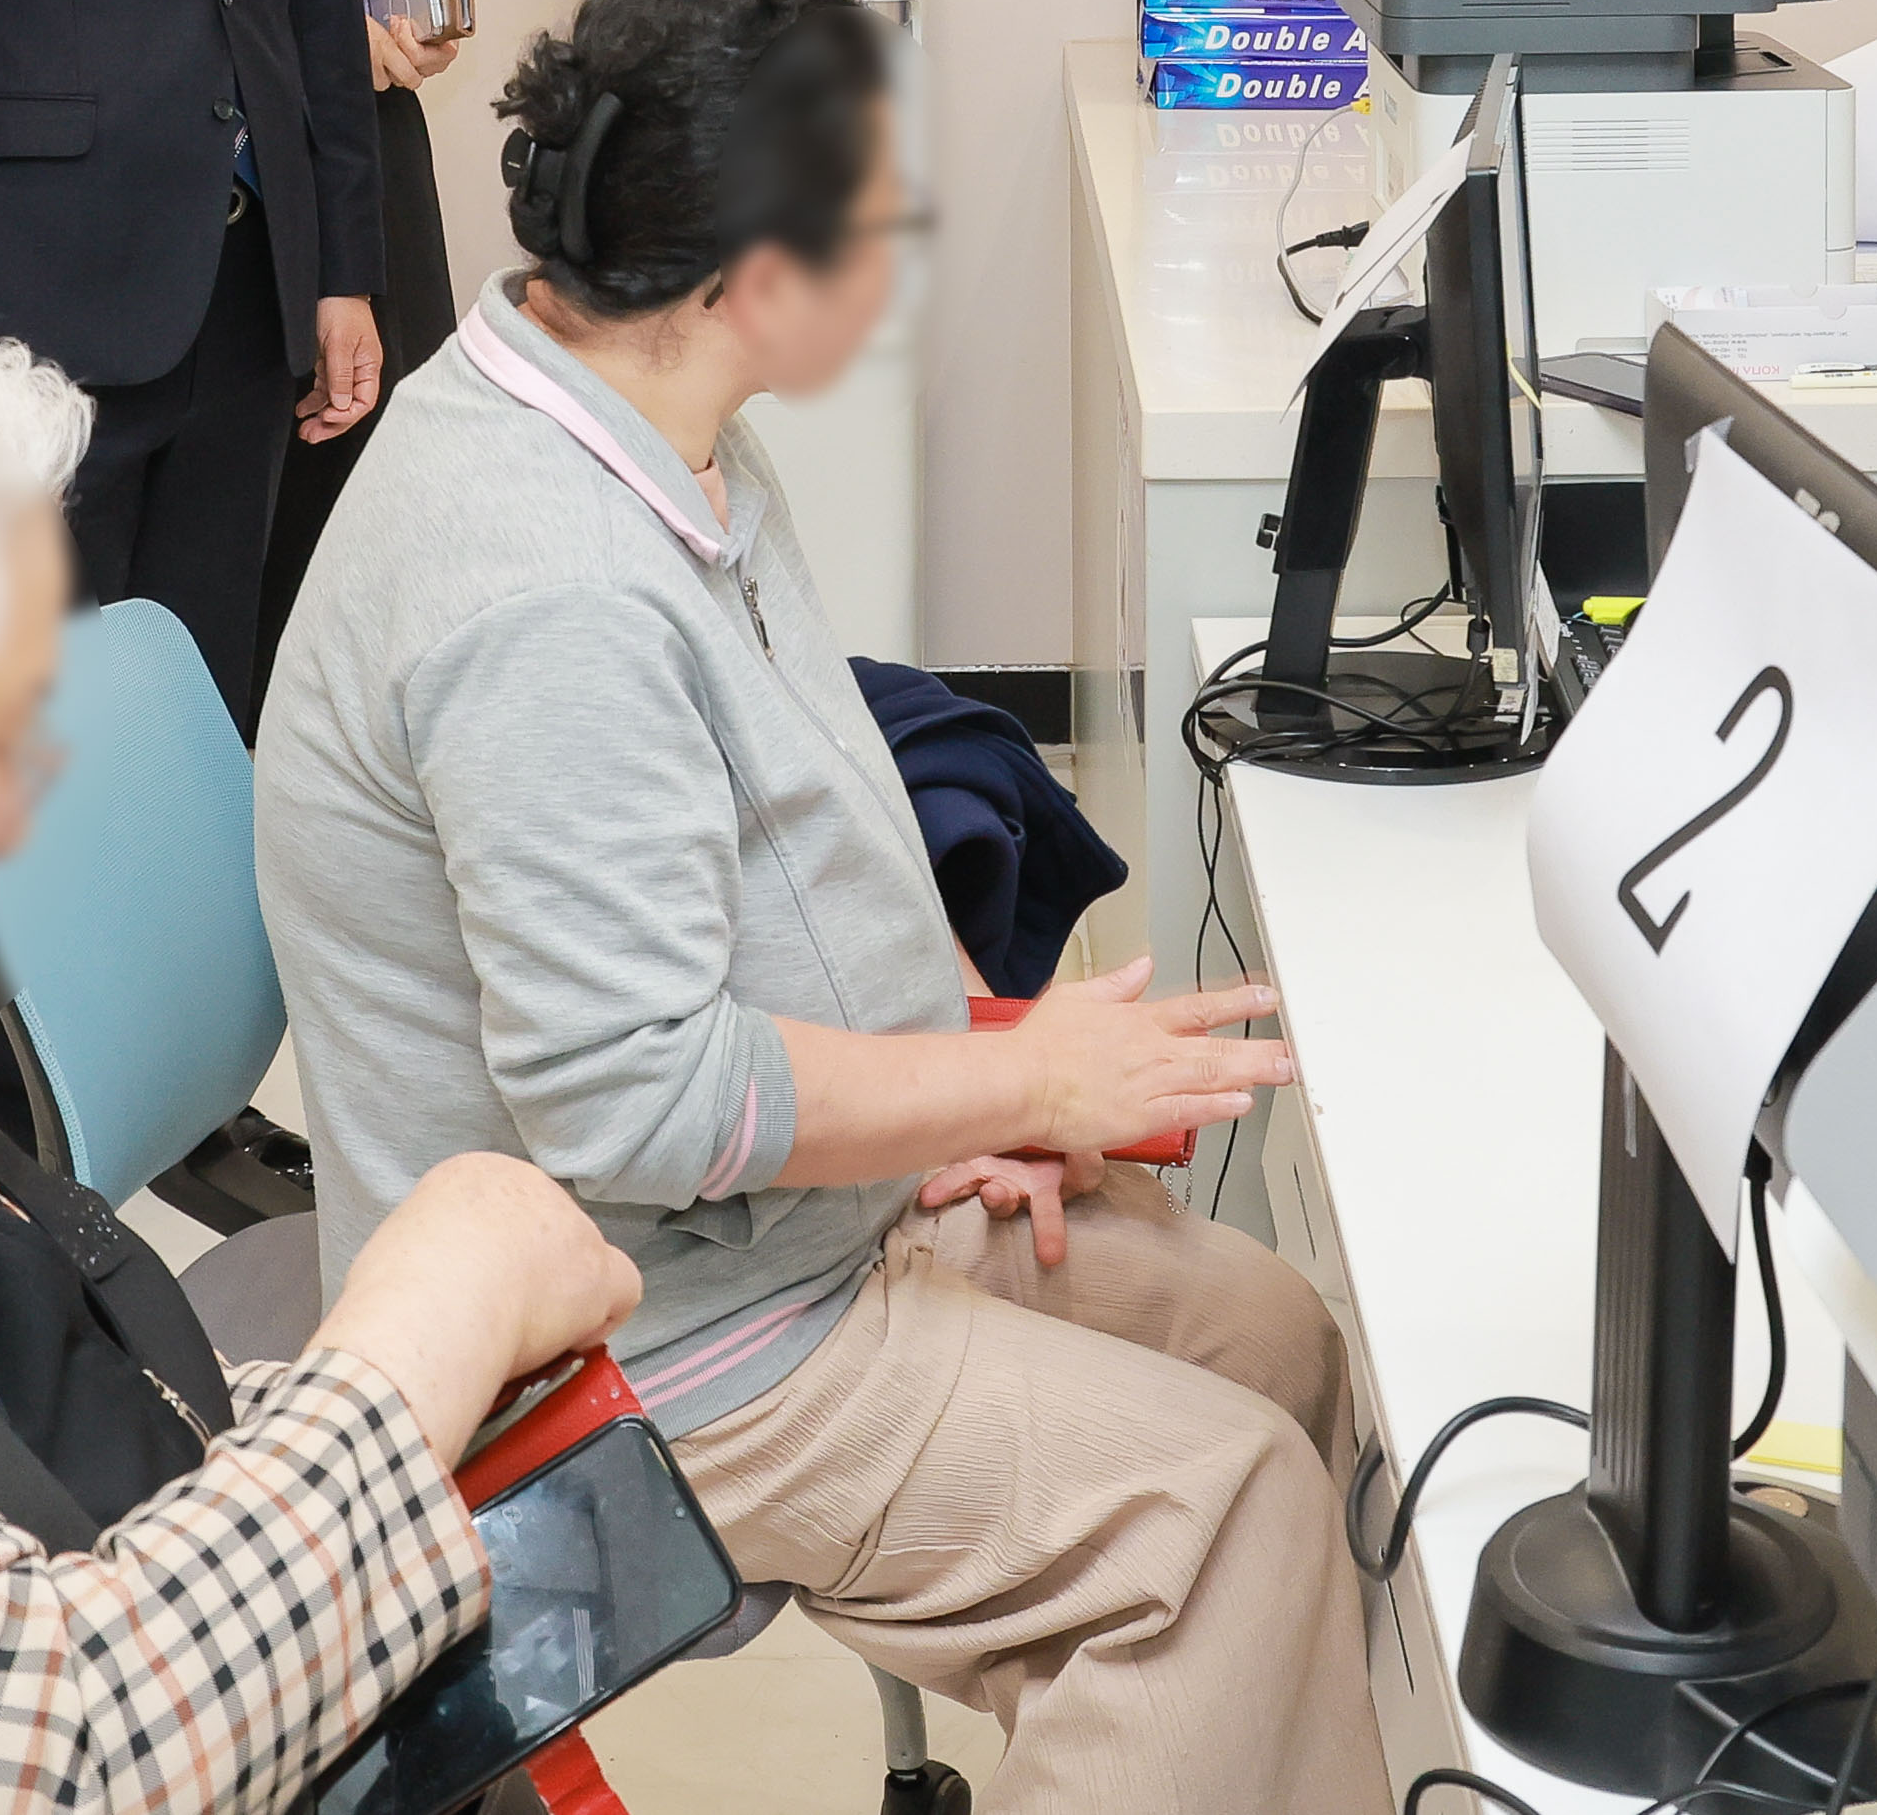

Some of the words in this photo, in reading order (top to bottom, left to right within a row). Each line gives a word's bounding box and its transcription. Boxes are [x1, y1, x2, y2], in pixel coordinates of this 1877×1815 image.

[1204, 25, 1330, 51] Double
[1342, 26, 1367, 51] A
[1215, 73, 1342, 99] Double
[1617, 665, 1793, 956] 2
